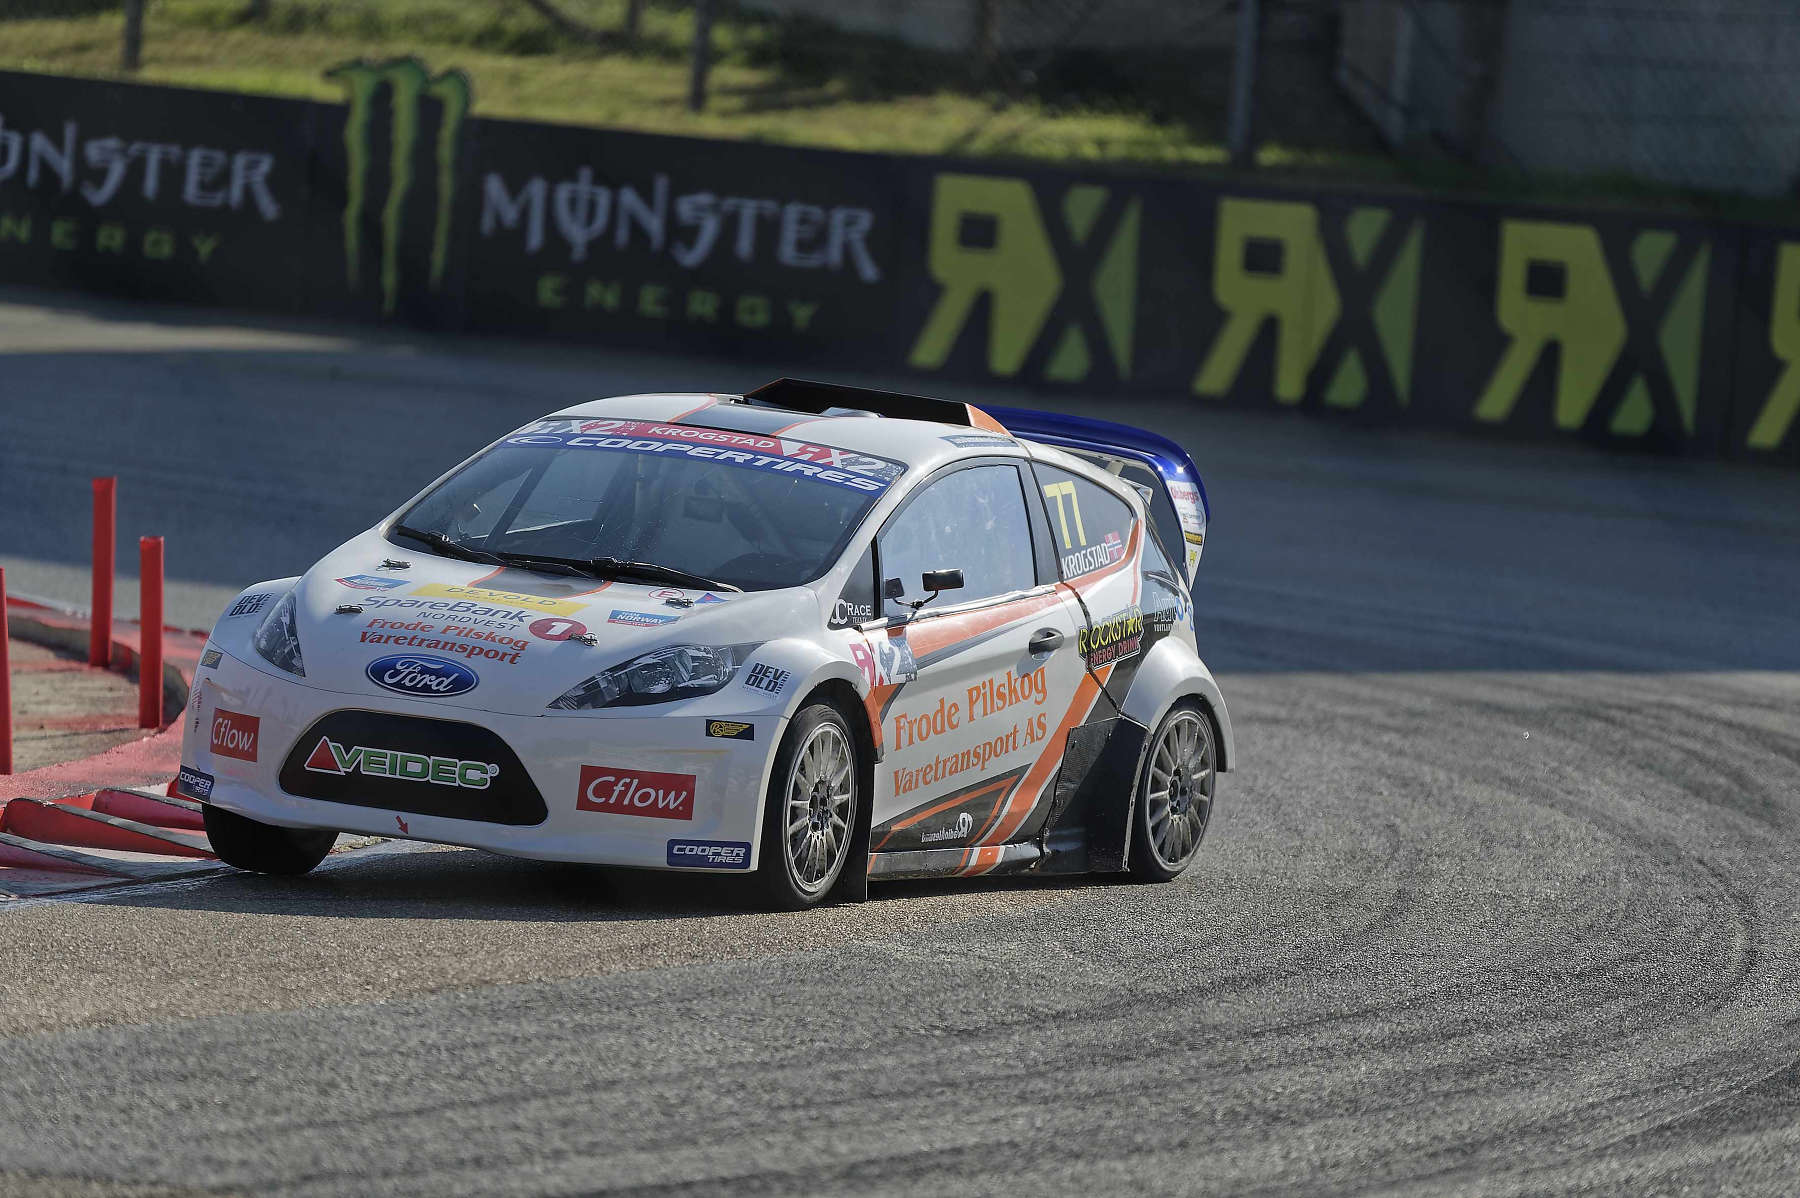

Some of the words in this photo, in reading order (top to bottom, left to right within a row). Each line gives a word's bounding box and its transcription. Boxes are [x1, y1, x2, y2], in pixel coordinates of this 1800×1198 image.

[482, 165, 883, 284] MONSTER
[536, 274, 820, 332] ENERGY
[647, 425, 776, 449] KROGSTAD
[1043, 481, 1087, 549] 77
[1062, 543, 1110, 579] KROGSTAD
[357, 594, 534, 624] SpareBank
[446, 586, 558, 606] DEVOLD
[847, 601, 872, 617] RACE
[366, 617, 434, 633] Frode
[440, 624, 532, 652] Pilskog
[415, 610, 521, 632] NORDVEST
[616, 614, 665, 624] NORWAY
[359, 630, 522, 665] Varetransport
[383, 656, 460, 694] Ford
[894, 696, 961, 752] Frode
[966, 666, 1048, 724] Pilskog
[893, 724, 1020, 798] Varetransport
[1022, 711, 1048, 748] AS
[180, 771, 212, 789] COOPER
[672, 844, 747, 857] COOPER
[707, 854, 744, 864] TIRES
